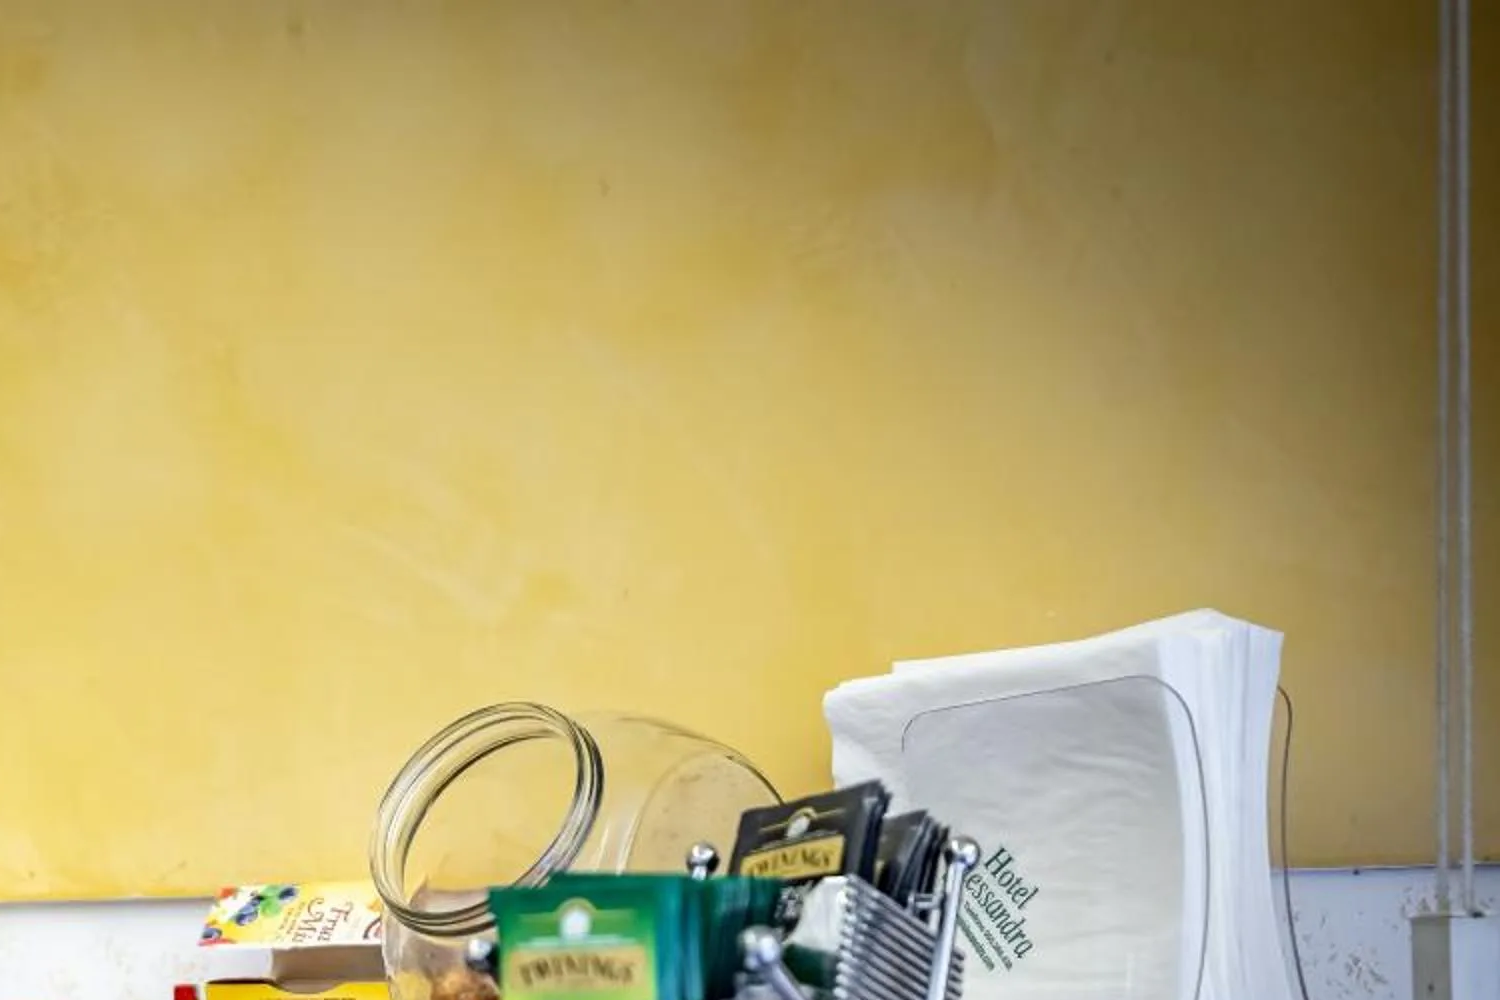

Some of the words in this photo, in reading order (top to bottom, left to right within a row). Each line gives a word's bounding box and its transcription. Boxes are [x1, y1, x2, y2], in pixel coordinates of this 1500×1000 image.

[984, 847, 1039, 909] Hotel
[964, 874, 1033, 958] essandra
[519, 953, 636, 986] TWININGS
